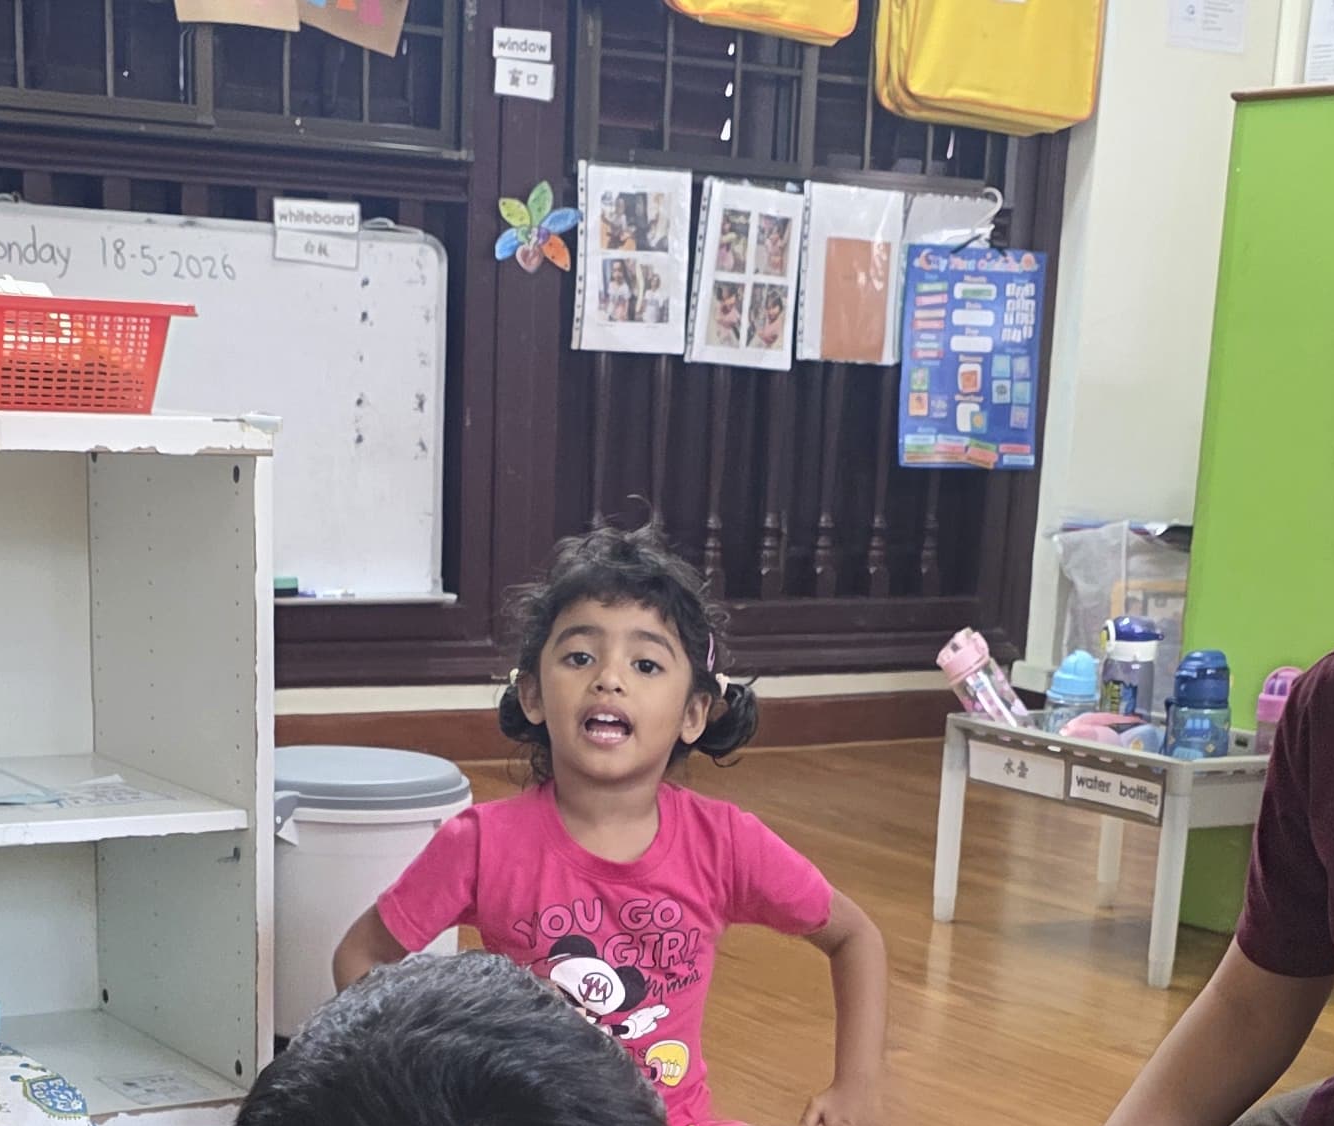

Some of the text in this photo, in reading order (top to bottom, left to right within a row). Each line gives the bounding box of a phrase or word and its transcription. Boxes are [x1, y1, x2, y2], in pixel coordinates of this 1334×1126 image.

[497, 36, 548, 54] window
[278, 208, 356, 226] whiteboard
[100, 236, 237, 281] 18-5-2026
[1075, 774, 1159, 807] water bottles
[513, 897, 683, 948] YOU GO
